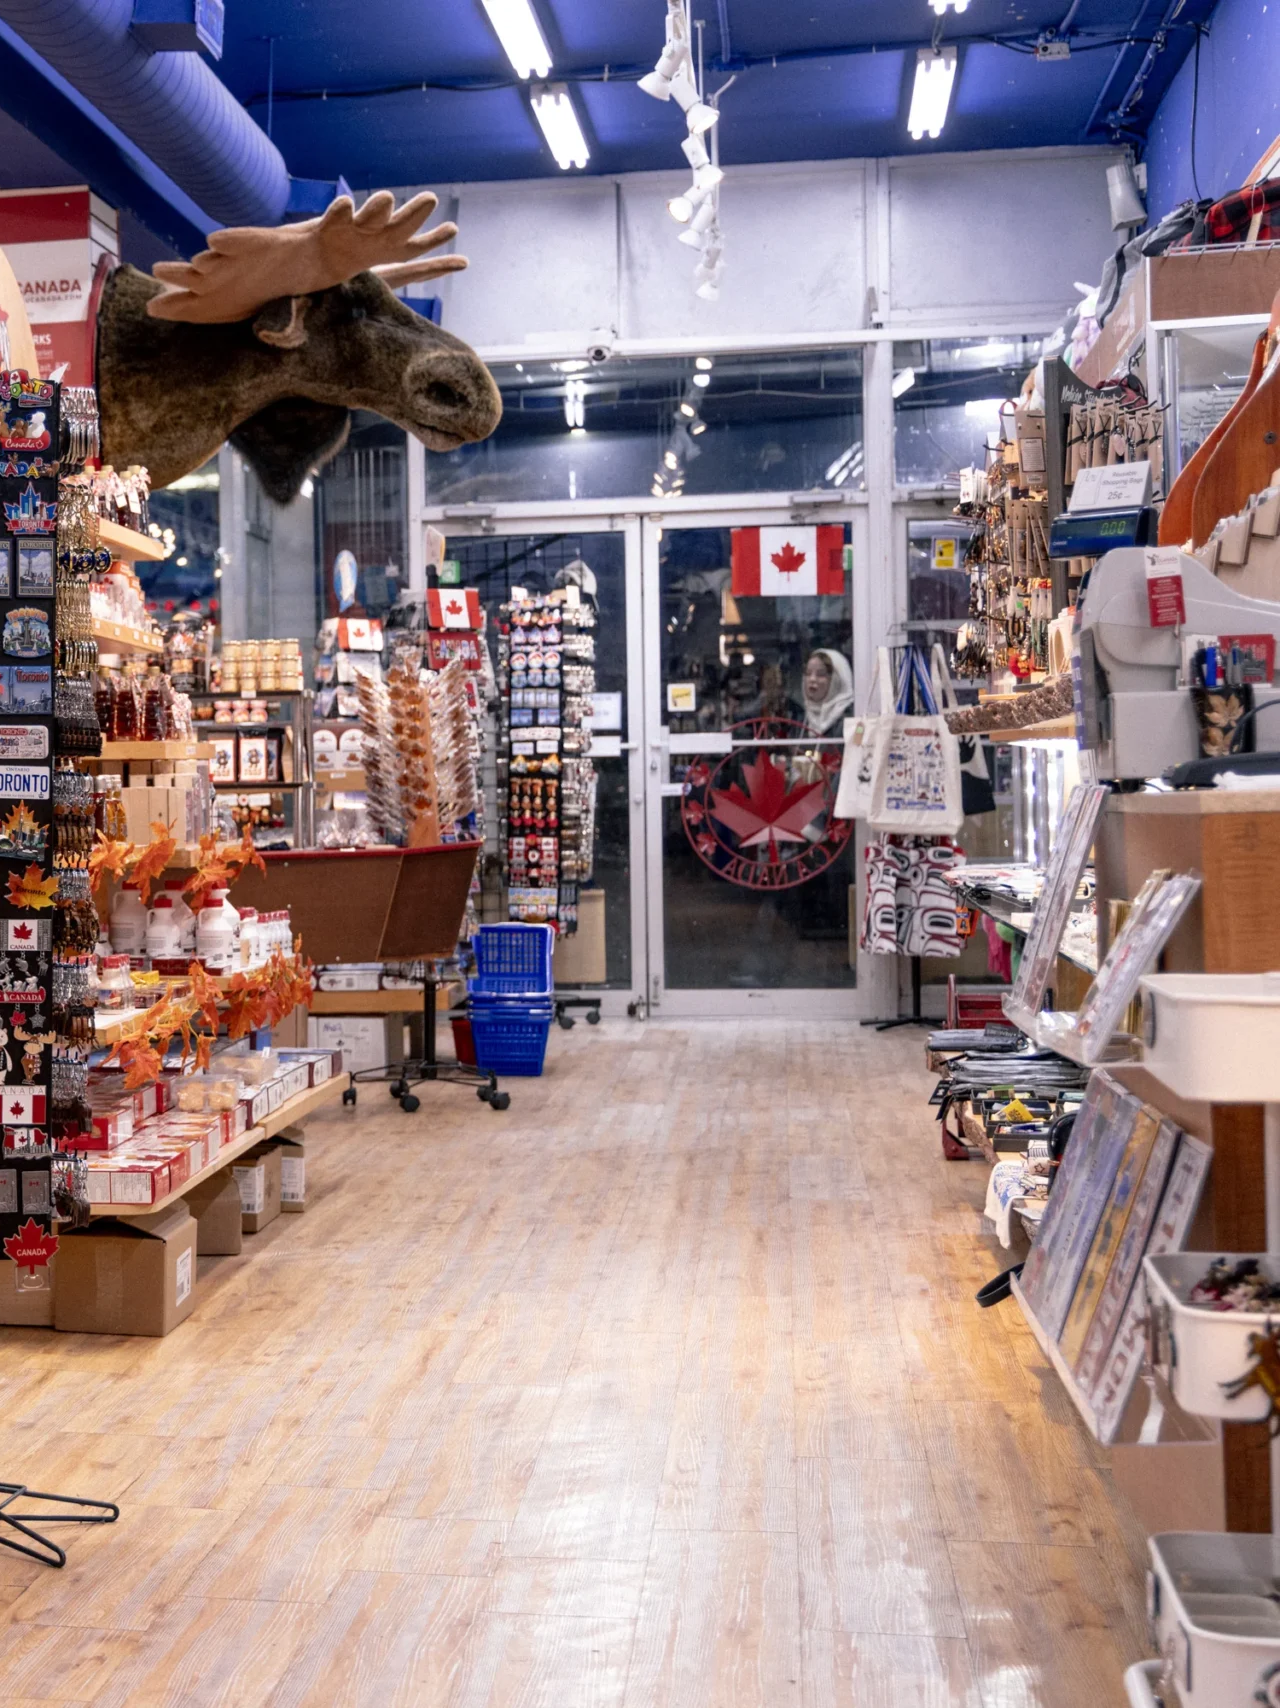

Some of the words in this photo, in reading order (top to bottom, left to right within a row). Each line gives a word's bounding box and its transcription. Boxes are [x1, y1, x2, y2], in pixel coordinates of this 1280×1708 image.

[4, 438, 36, 449] Canada
[1102, 477, 1128, 486] Shopping
[1129, 476, 1144, 485] Bags
[1107, 491, 1123, 500] 25¢
[18, 520, 44, 528] TORONTO
[1100, 521, 1127, 536] 0.00
[16, 669, 49, 682] Toronto
[15, 886, 46, 897] Toronto
[9, 993, 42, 1001] CANADA
[0, 1087, 45, 1095] ANADA
[17, 1248, 47, 1256] CANADA
